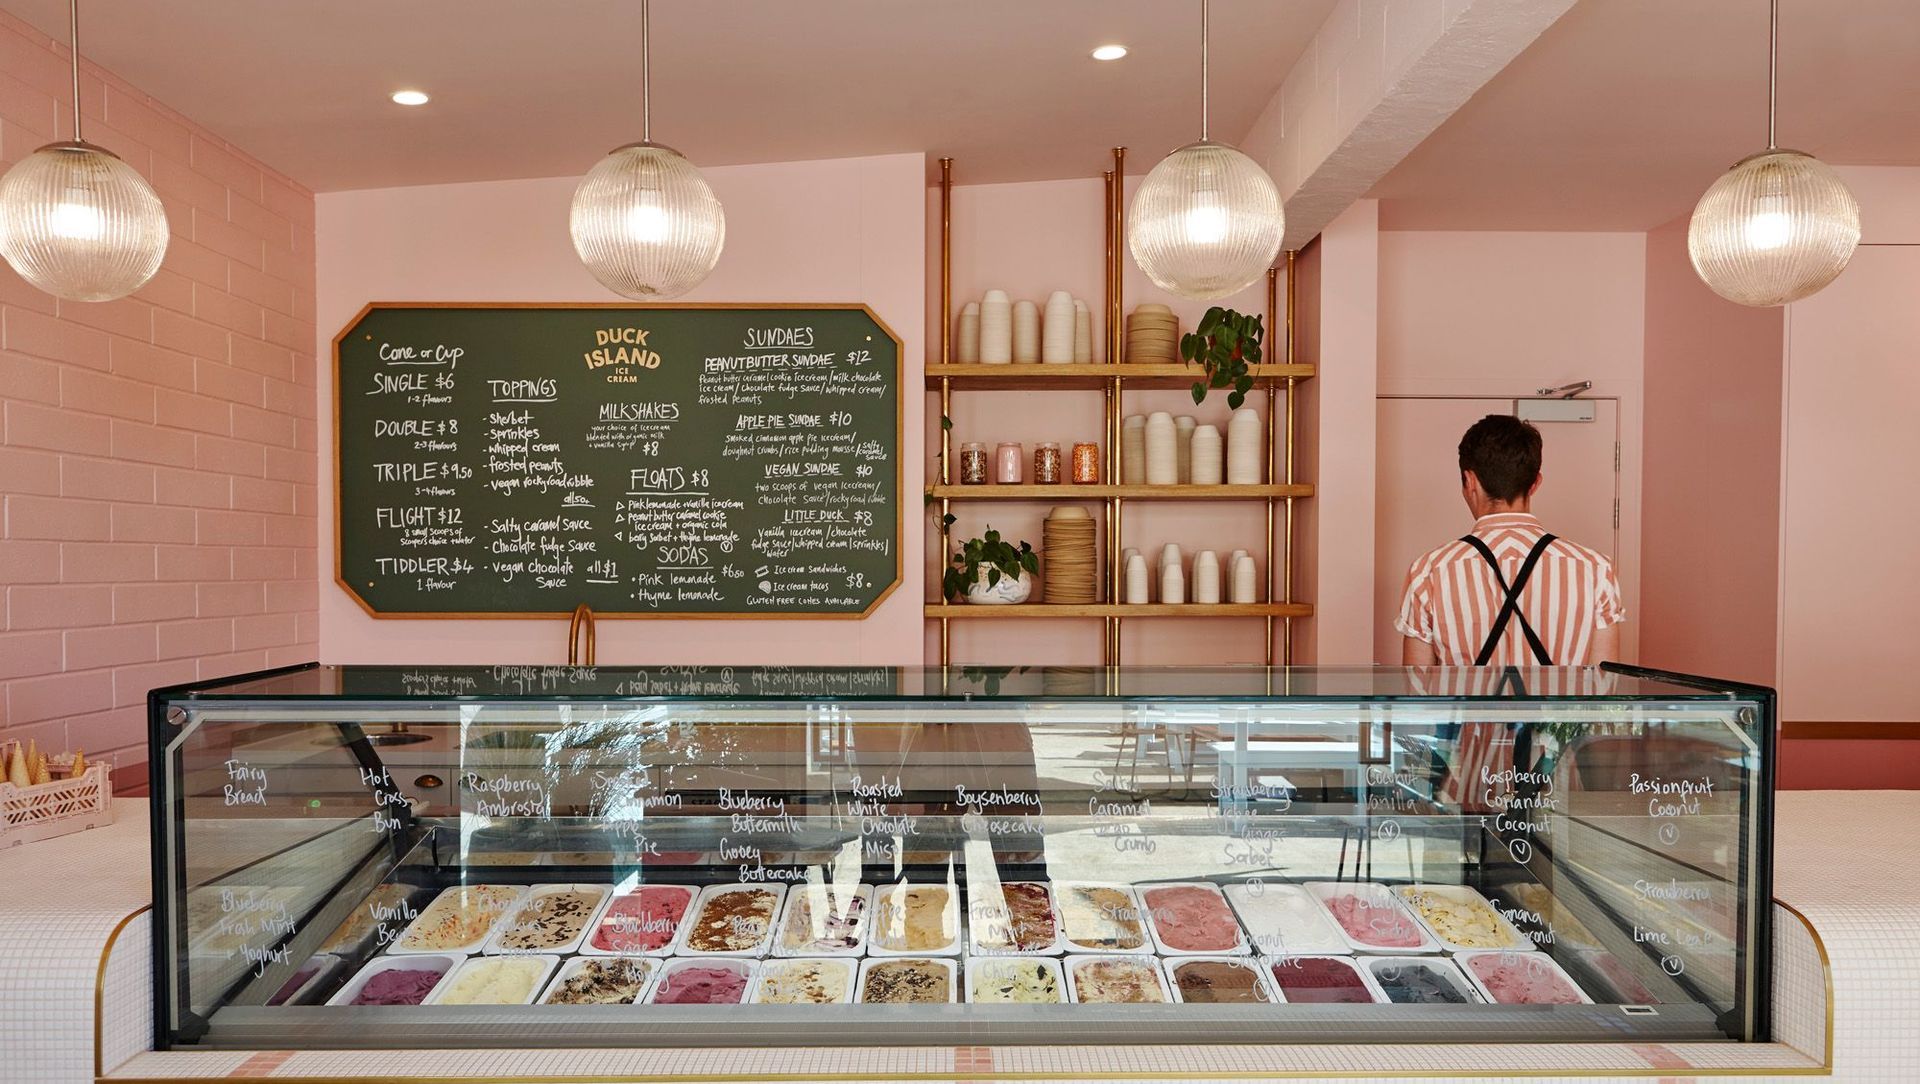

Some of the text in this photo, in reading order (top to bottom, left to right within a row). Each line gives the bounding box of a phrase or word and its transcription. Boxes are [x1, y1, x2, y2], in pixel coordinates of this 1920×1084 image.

[596, 328, 650, 346] DUCK
[744, 327, 813, 347] SUNDAES
[380, 343, 464, 369] Cone or Cup
[584, 347, 661, 370] ISLAND
[791, 350, 872, 368] SUNDAE $12
[607, 375, 637, 383] CREAM
[615, 367, 629, 375] ICE
[366, 372, 454, 395] SINGLE $6
[487, 377, 557, 398] TOPPINGS
[698, 394, 728, 405] frosted
[375, 420, 436, 438] DOUBLE
[789, 413, 822, 426] SUNDAE
[829, 411, 852, 427] $10
[642, 441, 659, 456] $8
[373, 462, 438, 482] TRIPLE
[489, 455, 527, 474] frosted
[765, 463, 800, 477] VEGAN
[803, 463, 841, 475] SUNDAE
[491, 477, 520, 496] vegan
[630, 466, 709, 491] FLOATS $8
[376, 506, 463, 528] FLIGHT $12
[785, 509, 873, 526] LITTLE DUCK $8
[657, 545, 708, 566] SODAS
[375, 557, 474, 576] TIDDLER $4
[587, 560, 619, 578] all $1
[670, 572, 717, 585] lemonade
[678, 587, 724, 601] lemonade
[225, 759, 267, 791] Fairy
[360, 766, 390, 787] Hot
[1481, 766, 1553, 794] Raspberry
[1629, 773, 1715, 797] Passionfruit
[224, 784, 267, 806] Bread
[467, 772, 543, 804] Raspberry
[851, 775, 903, 798] Roasted
[1210, 777, 1293, 812] Strawberry
[375, 790, 408, 807] Cross
[719, 787, 784, 818] Blueberry
[848, 799, 889, 817] White
[956, 784, 1043, 816] Boysenberry
[1484, 789, 1559, 810] Coriander
[374, 811, 401, 833] Bun
[732, 813, 802, 835] Buttermilk
[862, 815, 920, 836] Chocolate
[1496, 813, 1551, 833] Coconut
[633, 834, 662, 857] Pie
[720, 838, 761, 870] Gooey
[739, 864, 810, 883] Buttercake
[369, 898, 419, 921] Vanilla
[1634, 926, 1669, 945] Lime
[240, 943, 293, 979] Yoghurt
